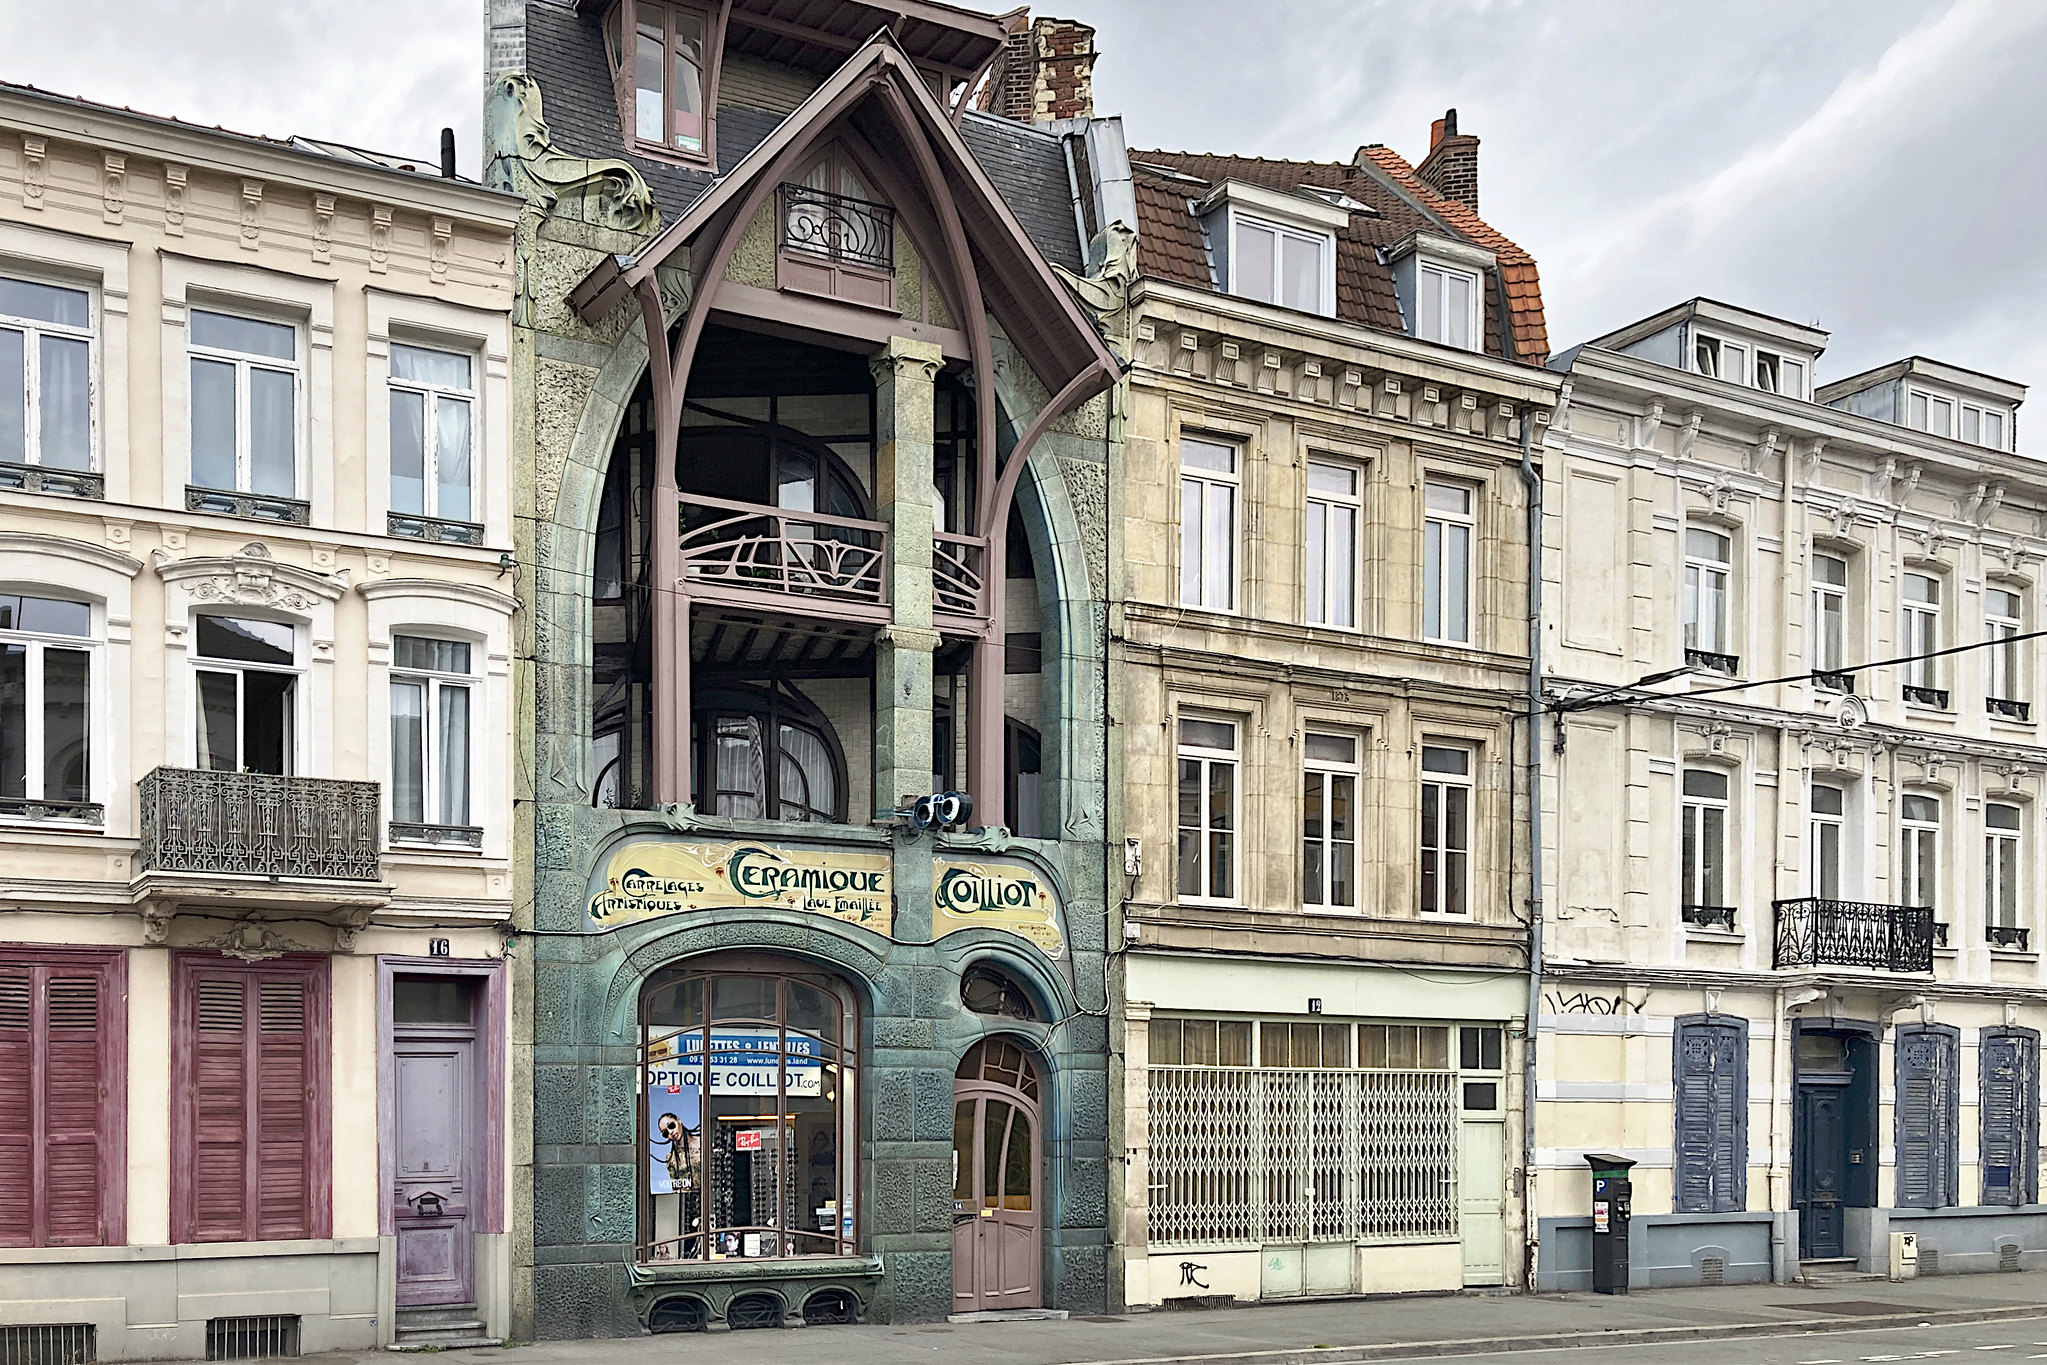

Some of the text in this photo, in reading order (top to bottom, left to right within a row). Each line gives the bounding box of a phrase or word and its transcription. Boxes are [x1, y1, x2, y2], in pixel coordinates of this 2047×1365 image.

[622, 868, 704, 898] CARRELAGES
[936, 868, 1037, 913] COILLIOT
[591, 889, 681, 919] ARTISTIQUES
[432, 940, 449, 955] 16
[1311, 999, 1321, 1012] 12
[689, 1055, 698, 1063] 09
[719, 1056, 728, 1064] 31
[729, 1056, 738, 1064] 28
[682, 1178, 692, 1188] ON
[1596, 1180, 1605, 1192] P
